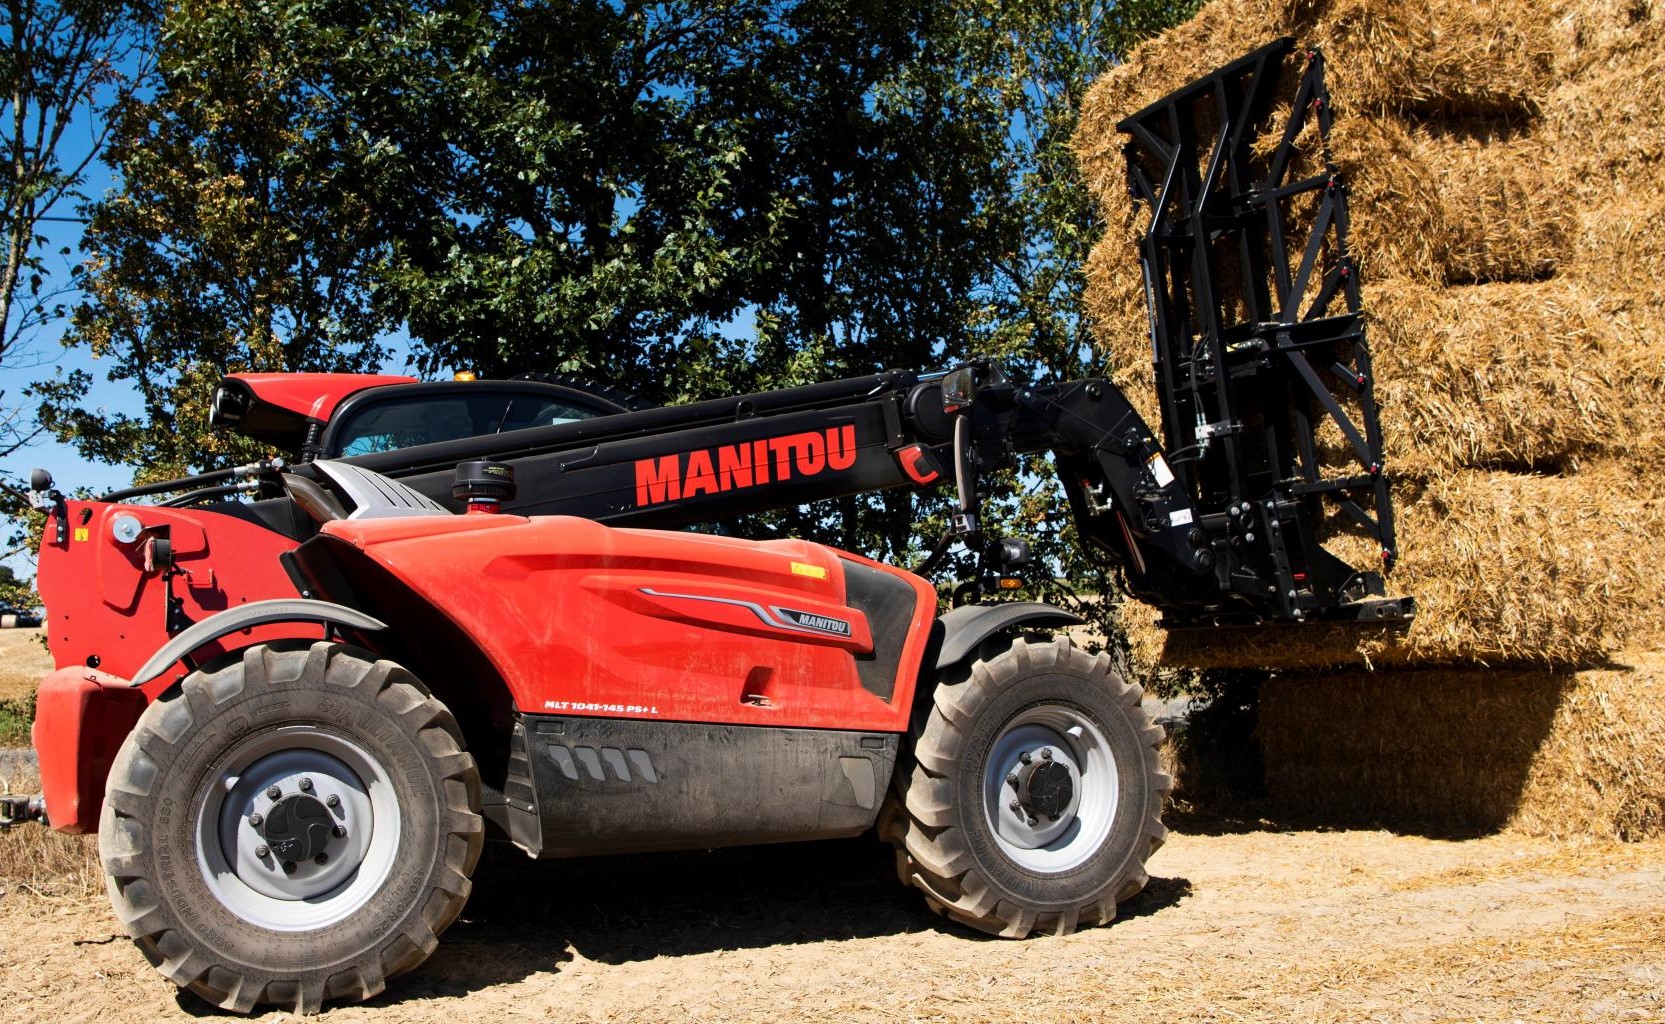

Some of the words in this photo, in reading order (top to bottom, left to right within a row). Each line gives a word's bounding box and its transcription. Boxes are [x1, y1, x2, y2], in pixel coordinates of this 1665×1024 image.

[634, 424, 856, 507] MANITOU
[799, 613, 846, 632] MANITOU
[544, 700, 569, 709] MLT
[571, 702, 624, 712] 1041-145
[626, 705, 649, 713] PS+
[651, 706, 658, 714] L
[157, 834, 199, 922] INDUSTRIAL
